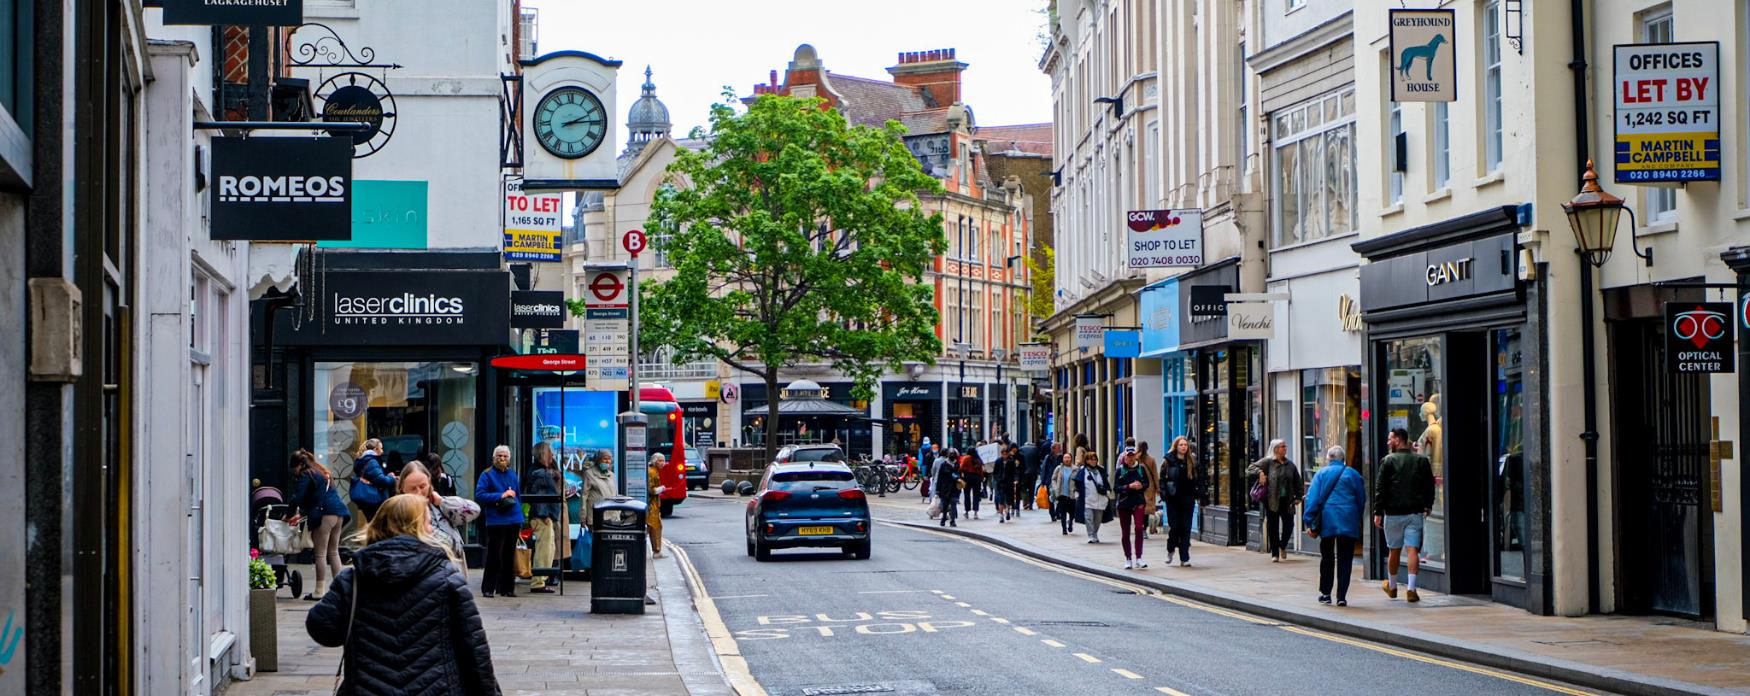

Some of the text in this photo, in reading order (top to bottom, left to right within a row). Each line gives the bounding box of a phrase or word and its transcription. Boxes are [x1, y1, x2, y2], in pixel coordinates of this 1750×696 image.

[1393, 17, 1451, 27] GREYHOUND
[1629, 52, 1703, 70] OFFICES
[1407, 83, 1440, 92] HOUSE
[1622, 76, 1709, 104] LET BY
[1624, 110, 1711, 129] 1,242 SQ FT
[1641, 140, 1694, 151] MARTIN
[1632, 151, 1703, 163] CAMPBELL
[1630, 171, 1649, 179] 020
[1652, 170, 1678, 179] 8940
[1681, 169, 1705, 178] 2266
[219, 176, 344, 197] ROMEOS
[507, 196, 560, 213] TO LET
[512, 216, 556, 226] 1,165 SQ FT
[1129, 212, 1155, 221] GCW.
[513, 241, 552, 249] CAMPBELL
[629, 230, 641, 250] B
[1134, 239, 1196, 251] SHOP TO LET
[1131, 255, 1200, 266] 020 7408 0030
[1426, 257, 1470, 286] GANT
[335, 292, 463, 313] laserclinics
[514, 303, 560, 312] laserclinics
[335, 317, 464, 325] UNITED KINGDOM
[1231, 313, 1271, 329] Venchi
[1678, 351, 1723, 360] OPTICAL
[1679, 362, 1721, 371] CENTER
[757, 610, 932, 625] BUS
[734, 621, 976, 640] STOP
